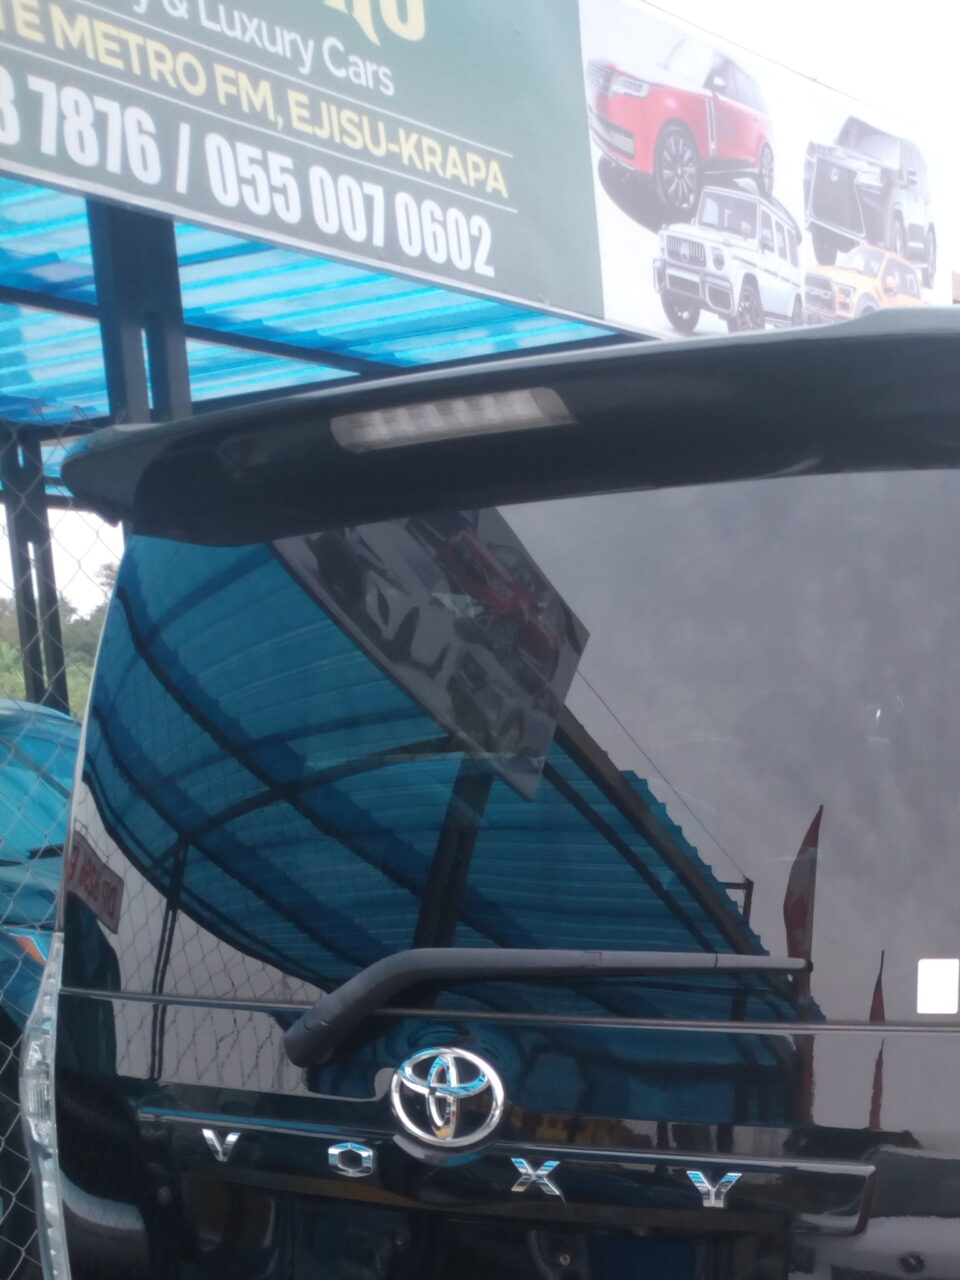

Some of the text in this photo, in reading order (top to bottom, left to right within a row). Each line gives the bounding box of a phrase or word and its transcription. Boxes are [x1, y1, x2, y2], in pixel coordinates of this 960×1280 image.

[50, 3, 207, 97] METRO
[213, 62, 284, 131] FM,
[286, 88, 510, 200] EJISU-KRAPA
[198, 0, 315, 75] Luxury
[322, 35, 395, 97] Cars
[26, 73, 163, 186] 7876
[204, 132, 301, 224] 055
[308, 164, 386, 248] 007
[394, 191, 496, 278] 0602
